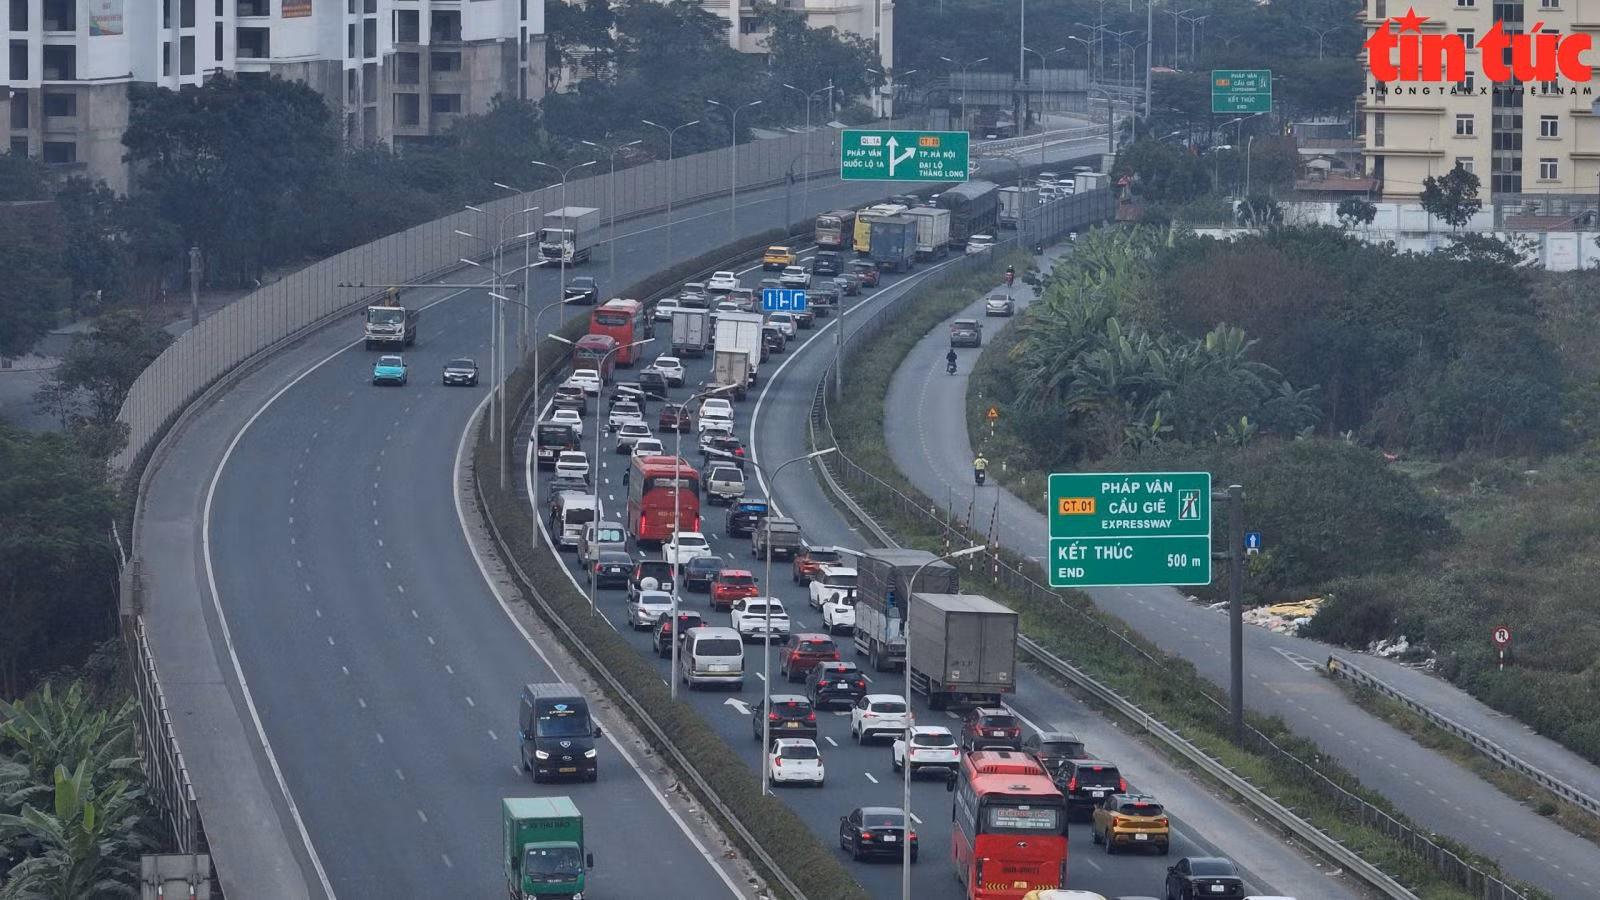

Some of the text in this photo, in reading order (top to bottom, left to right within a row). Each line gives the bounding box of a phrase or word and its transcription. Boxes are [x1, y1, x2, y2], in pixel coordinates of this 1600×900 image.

[847, 148, 865, 157] PHÁP
[943, 149, 956, 160] NỘI
[843, 158, 863, 167] QUỐC
[944, 170, 964, 178] LONG
[1101, 478, 1173, 494] PHÁP VÂN
[1063, 500, 1093, 512] CT.01
[1108, 497, 1166, 514] CẦU GIẼ
[1101, 519, 1172, 529] EXPRESSWAY
[1058, 541, 1134, 560] KẾT THÚC
[1167, 553, 1201, 567] 500 m
[1058, 567, 1085, 578] END
